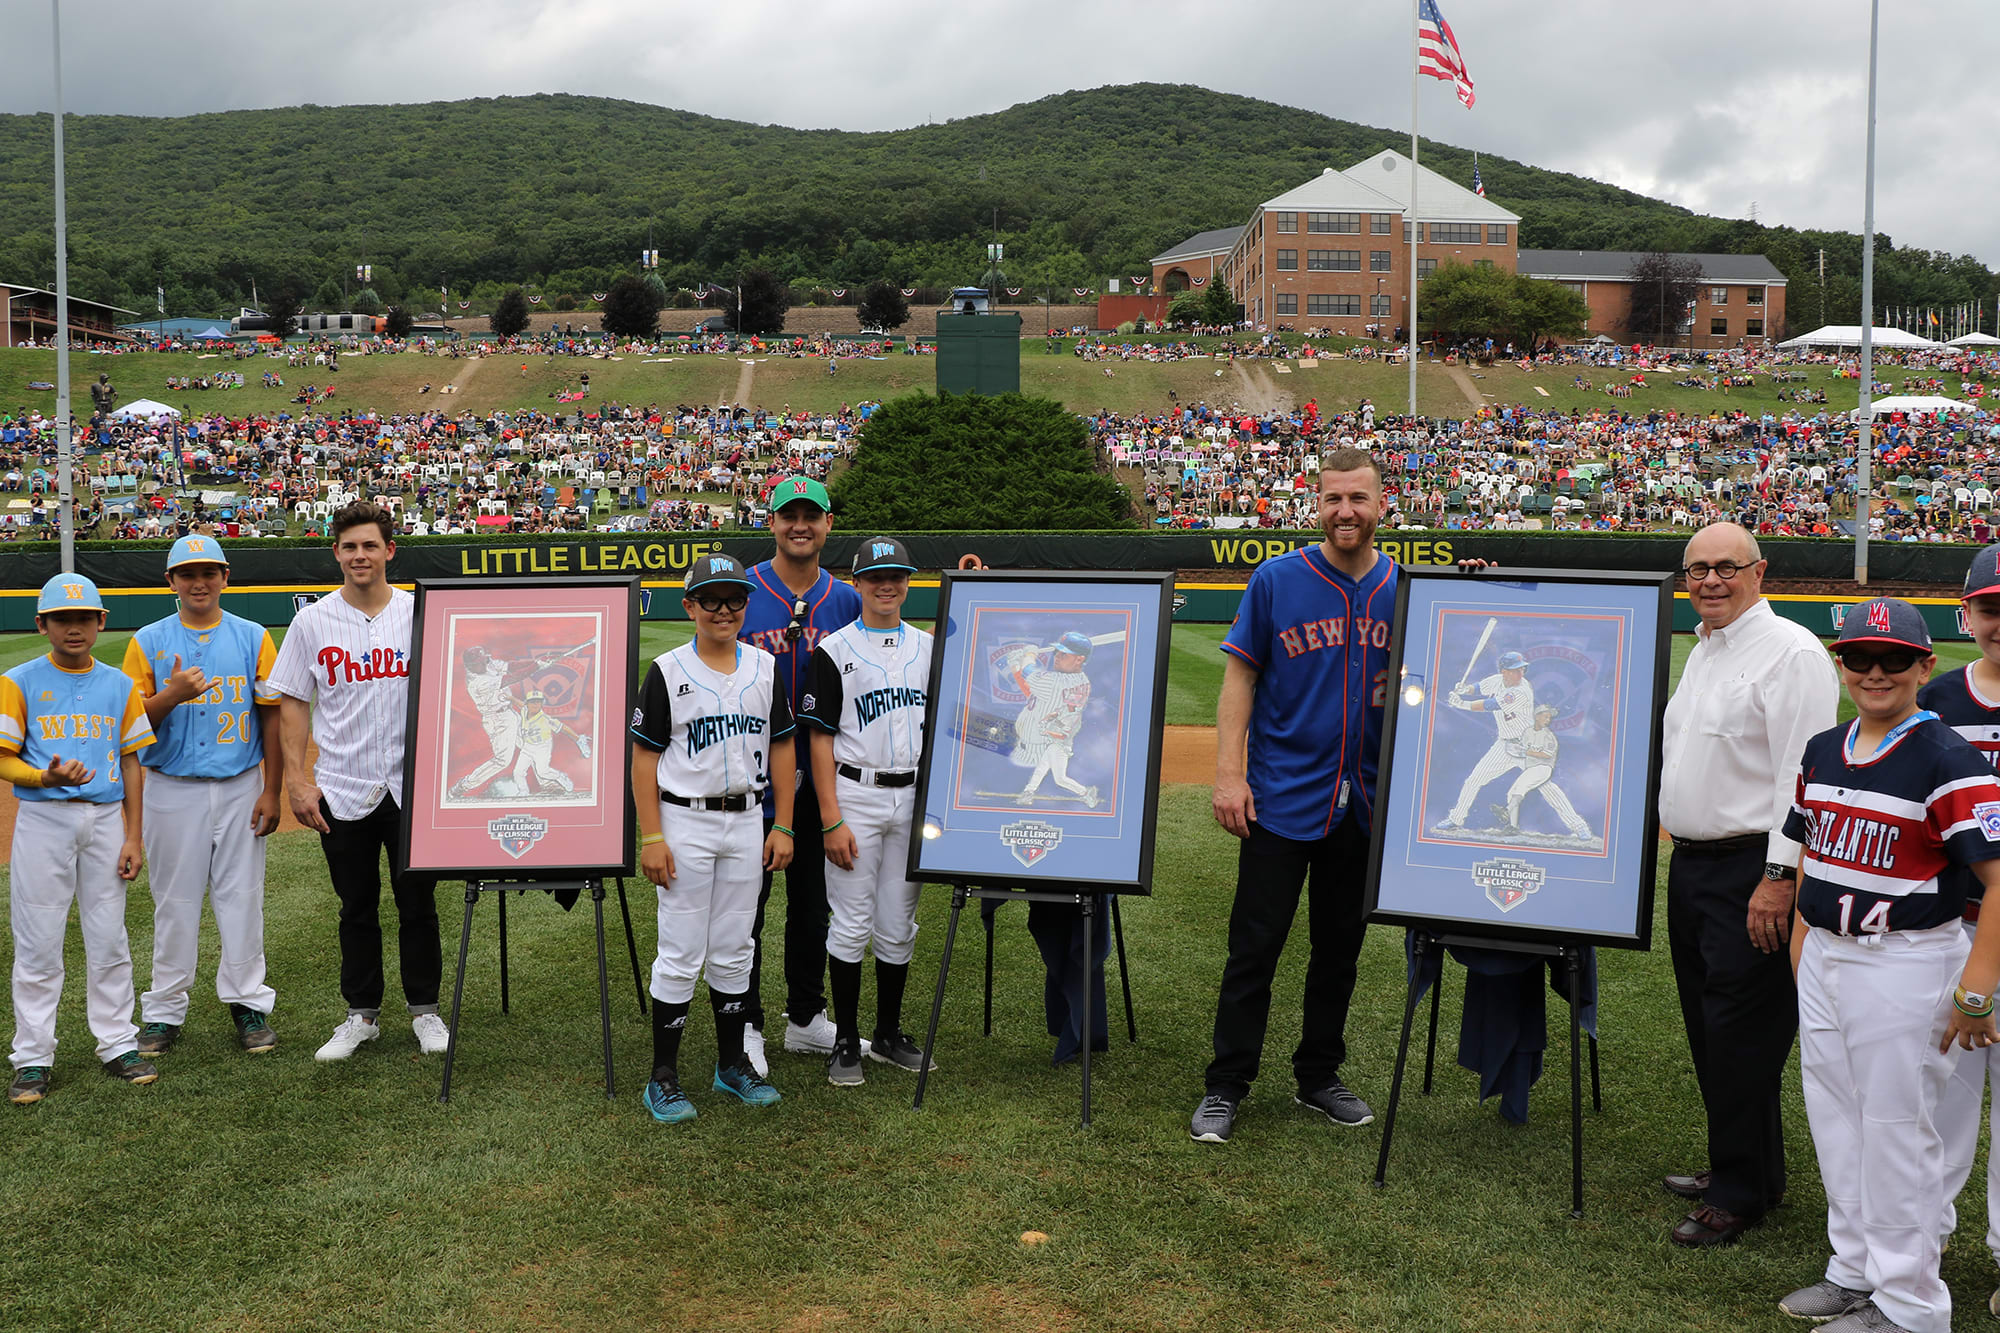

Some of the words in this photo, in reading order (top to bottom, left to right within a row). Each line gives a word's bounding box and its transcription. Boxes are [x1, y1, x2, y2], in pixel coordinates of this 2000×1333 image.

[793, 481, 808, 494] M
[185, 540, 205, 553] W
[871, 542, 895, 560] NW
[1211, 539, 1322, 564] WOR
[1372, 541, 1454, 566] RIES
[461, 547, 569, 575] LITTLE
[709, 557, 734, 575] NW
[61, 584, 84, 600] W
[1866, 602, 1890, 632] MA
[741, 628, 791, 655] EW
[1279, 617, 1346, 658] NEW
[1356, 617, 1392, 650] YO
[317, 645, 411, 687] Philli
[36, 714, 116, 740] WEST
[217, 711, 251, 744] 20
[492, 823, 516, 831] LITTLE
[1005, 829, 1029, 838] LITTLE
[1477, 867, 1505, 877] LITTLE
[1506, 869, 1540, 880] LEAGUE
[1491, 878, 1524, 888] CLASSIC
[1838, 894, 1894, 936] 14
